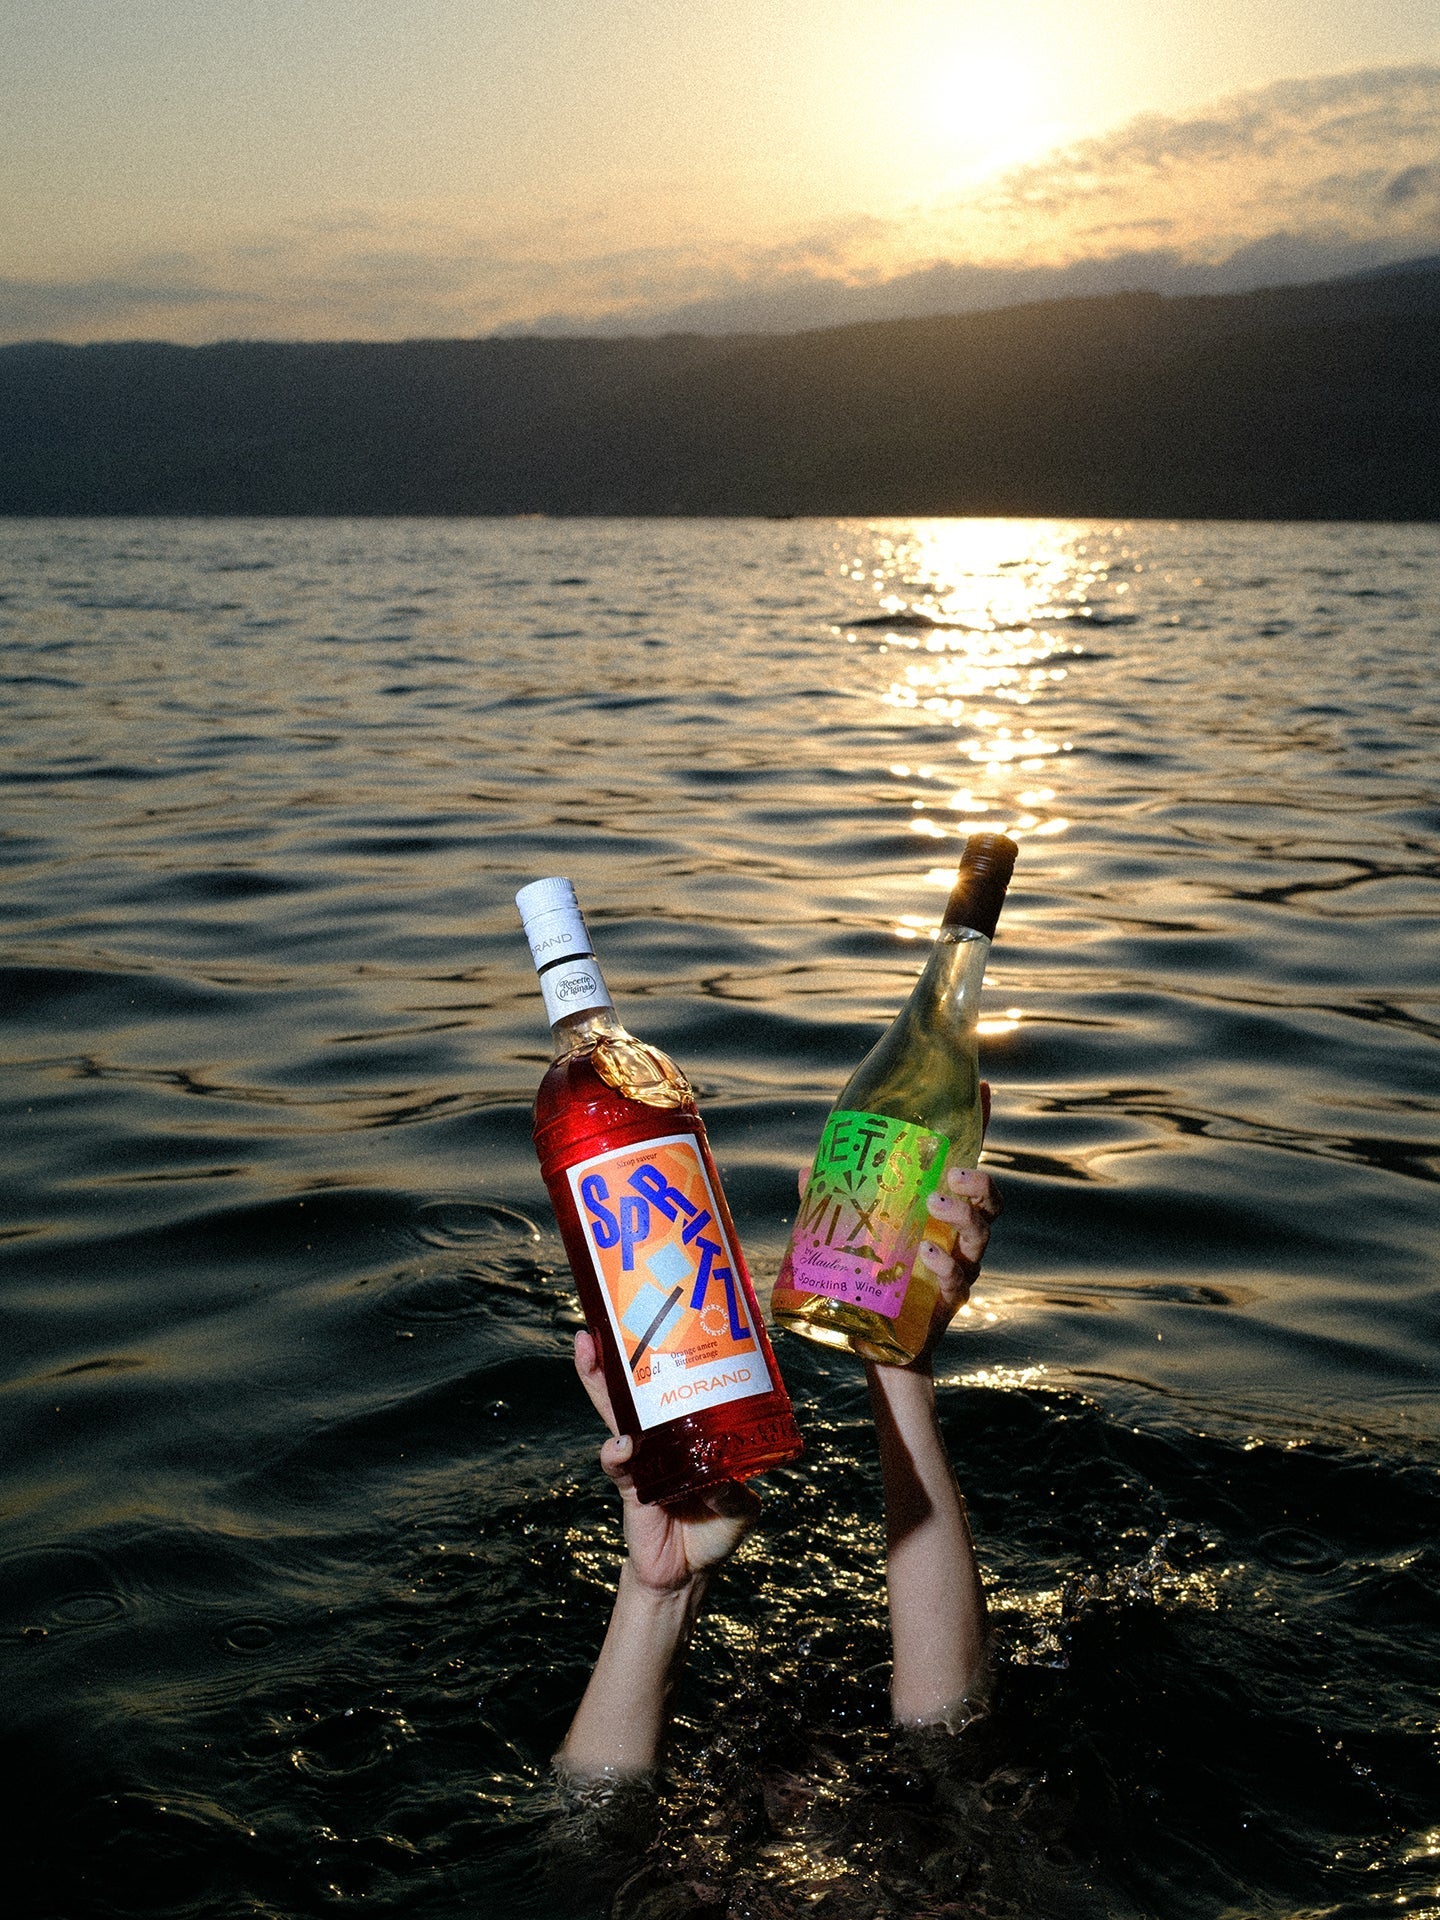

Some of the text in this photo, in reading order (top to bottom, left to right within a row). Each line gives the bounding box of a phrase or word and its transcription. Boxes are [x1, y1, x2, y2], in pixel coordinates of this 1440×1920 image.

[559, 976, 590, 990] Recette
[797, 1188, 882, 1247] MIX
[580, 1163, 751, 1342] SPRITZ
[798, 1272, 882, 1298] Sparkling Wine
[670, 1340, 719, 1359] Orange amère
[674, 1349, 719, 1368] Bitterorange
[660, 1368, 753, 1407] MORAND
